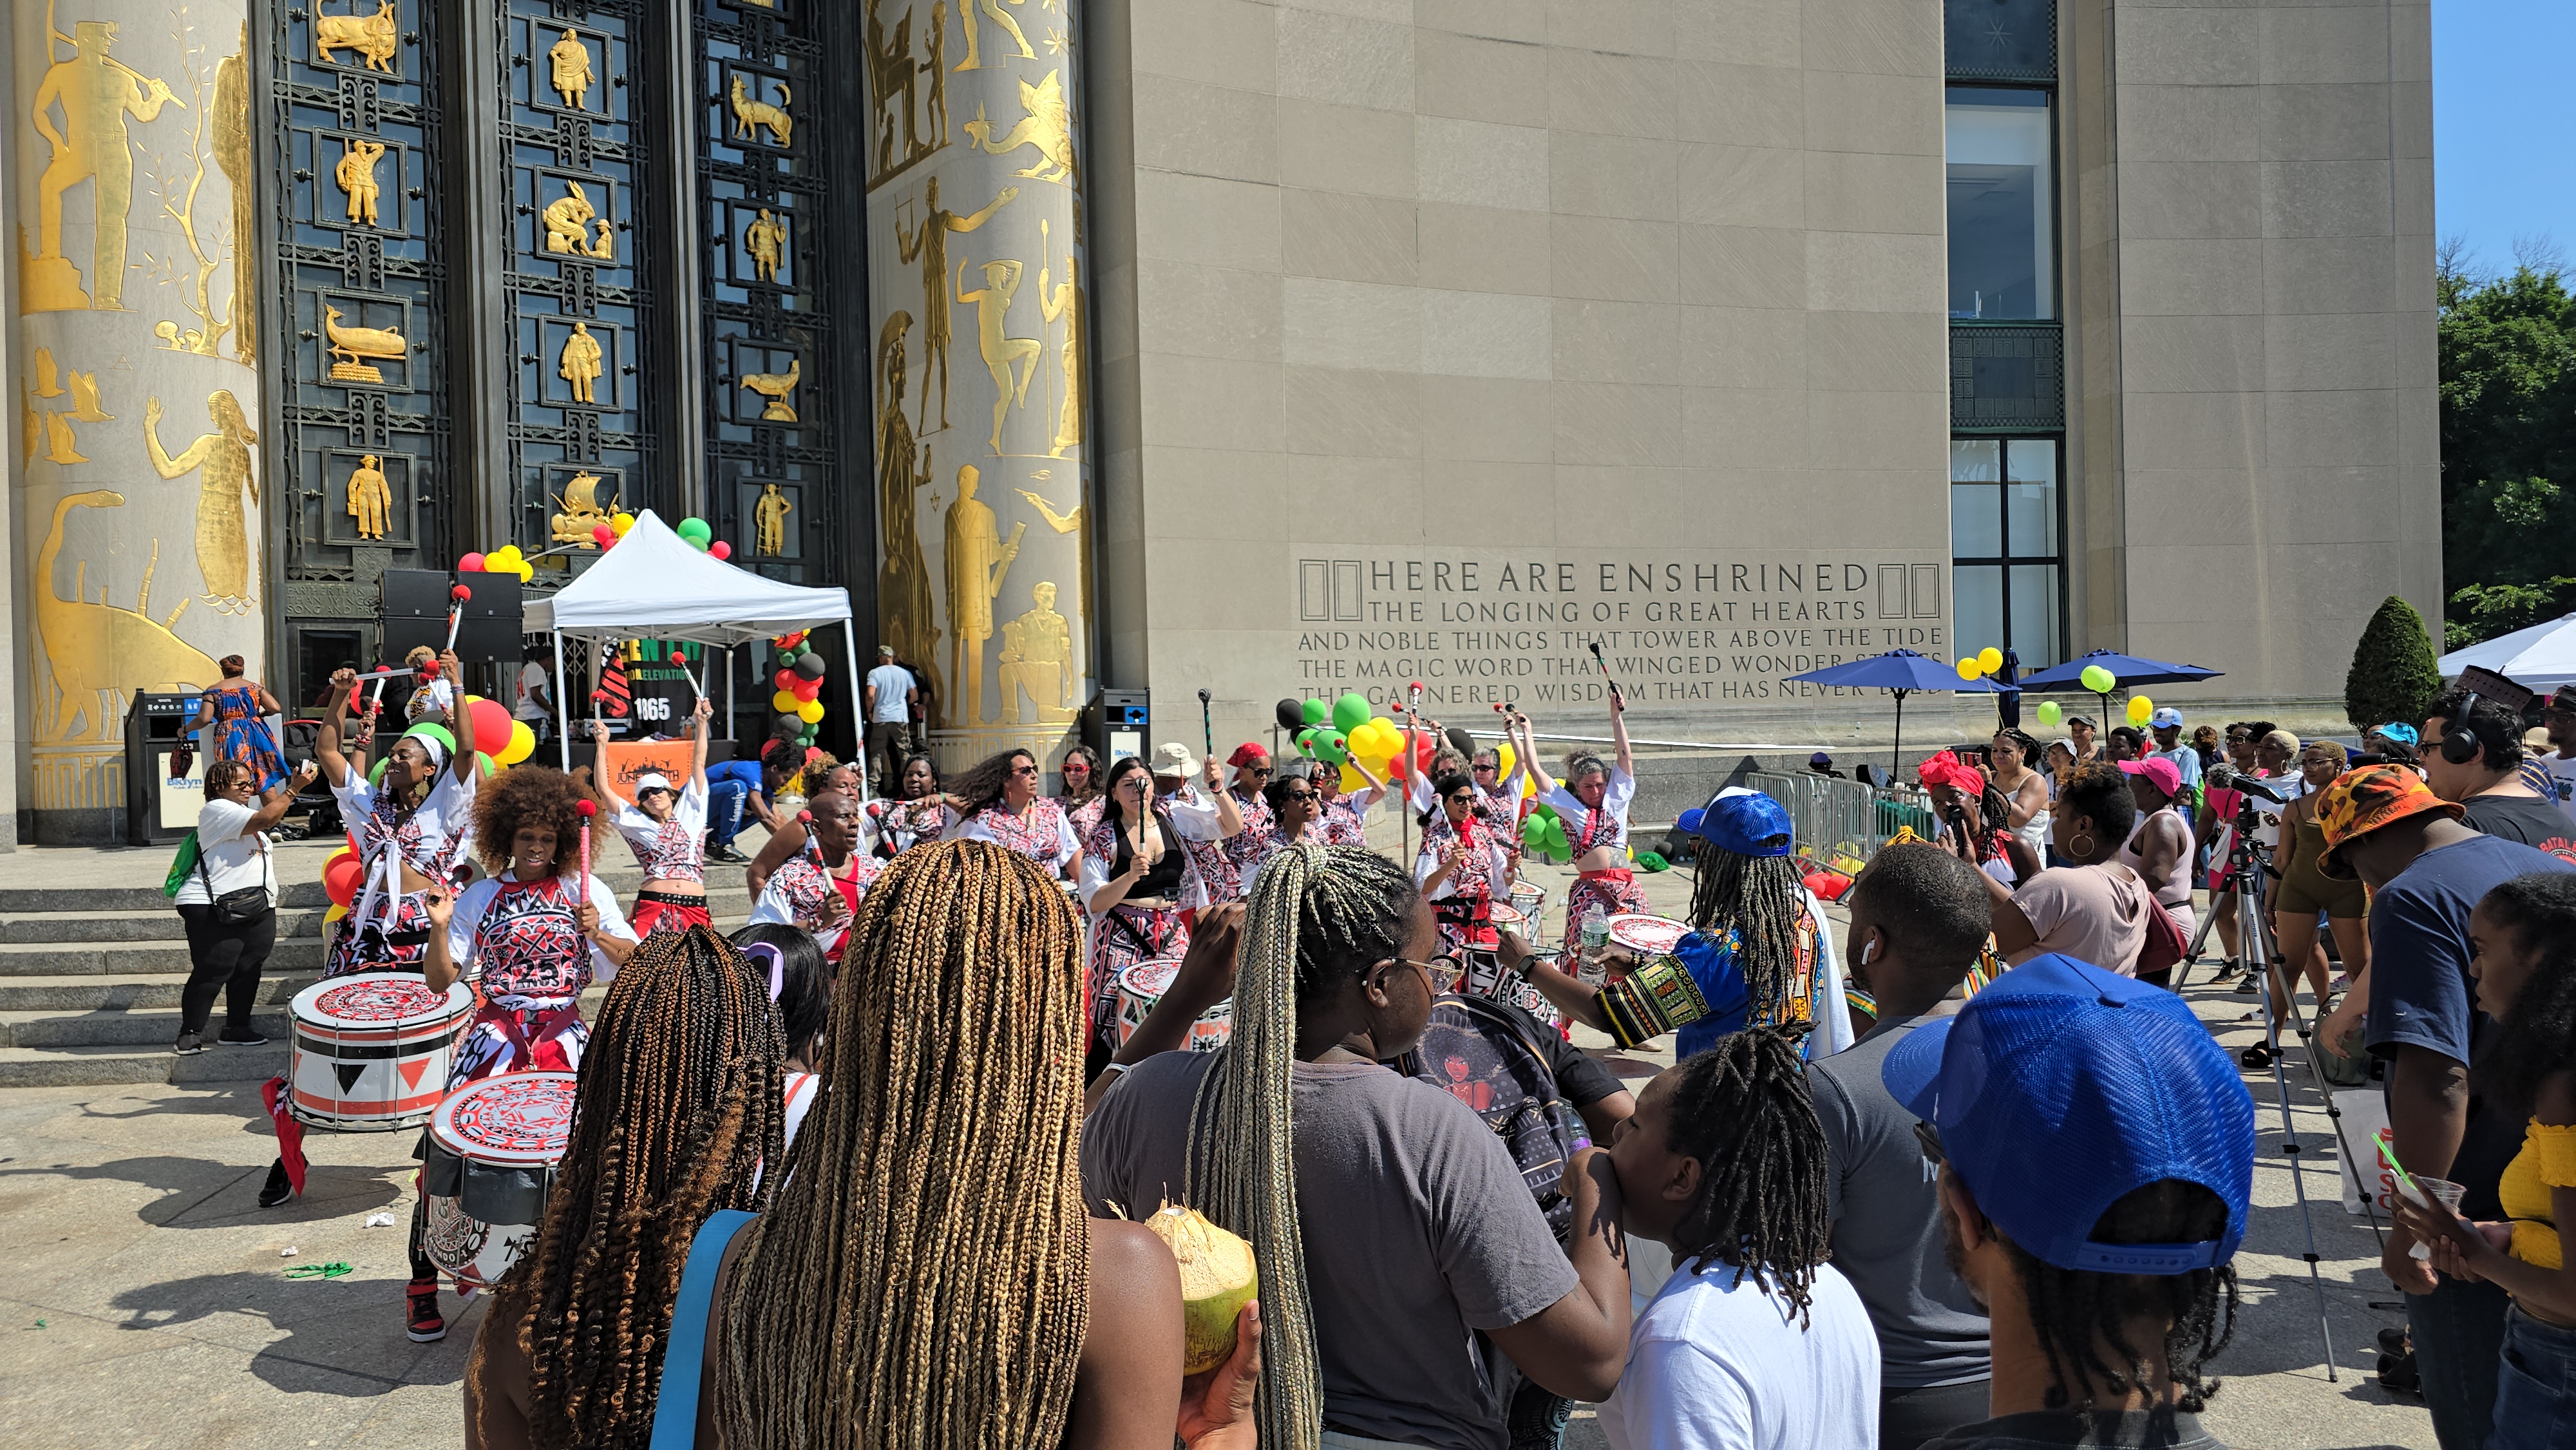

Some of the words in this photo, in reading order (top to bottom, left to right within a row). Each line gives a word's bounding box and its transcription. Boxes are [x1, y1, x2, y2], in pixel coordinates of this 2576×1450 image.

[1370, 561, 1479, 592] HERE
[1498, 561, 1576, 592] ARE
[1599, 563, 1868, 592] ENSHRINED
[287, 604, 322, 614] SONG
[1368, 601, 1423, 622] THE
[1441, 601, 1578, 623] LONGING
[1593, 601, 1630, 622] OF
[1645, 601, 1738, 622] GREAT
[1752, 601, 1864, 621] HEARTS
[1298, 632, 1349, 650] AND
[1359, 632, 1439, 650] NOBLE
[1452, 632, 1547, 650] THINGS
[1560, 631, 1621, 649] THAT
[1629, 630, 1718, 649] TOWER
[1730, 630, 1811, 648] ABOVE
[1823, 628, 1870, 646] THE
[1882, 628, 1942, 645] TIDE
[642, 668, 689, 681] ELEVATIO
[1298, 660, 1345, 678] THE
[1356, 659, 1444, 677] MAGIC
[1454, 658, 1532, 676] WORD
[1542, 657, 1604, 675] THAT
[1615, 656, 1721, 675] WINGED
[1732, 654, 1841, 673] WONDER
[1654, 682, 1713, 700] THAT
[1723, 681, 1768, 699] HAS
[1779, 680, 1864, 698] NEVER
[634, 697, 670, 720] 1865
